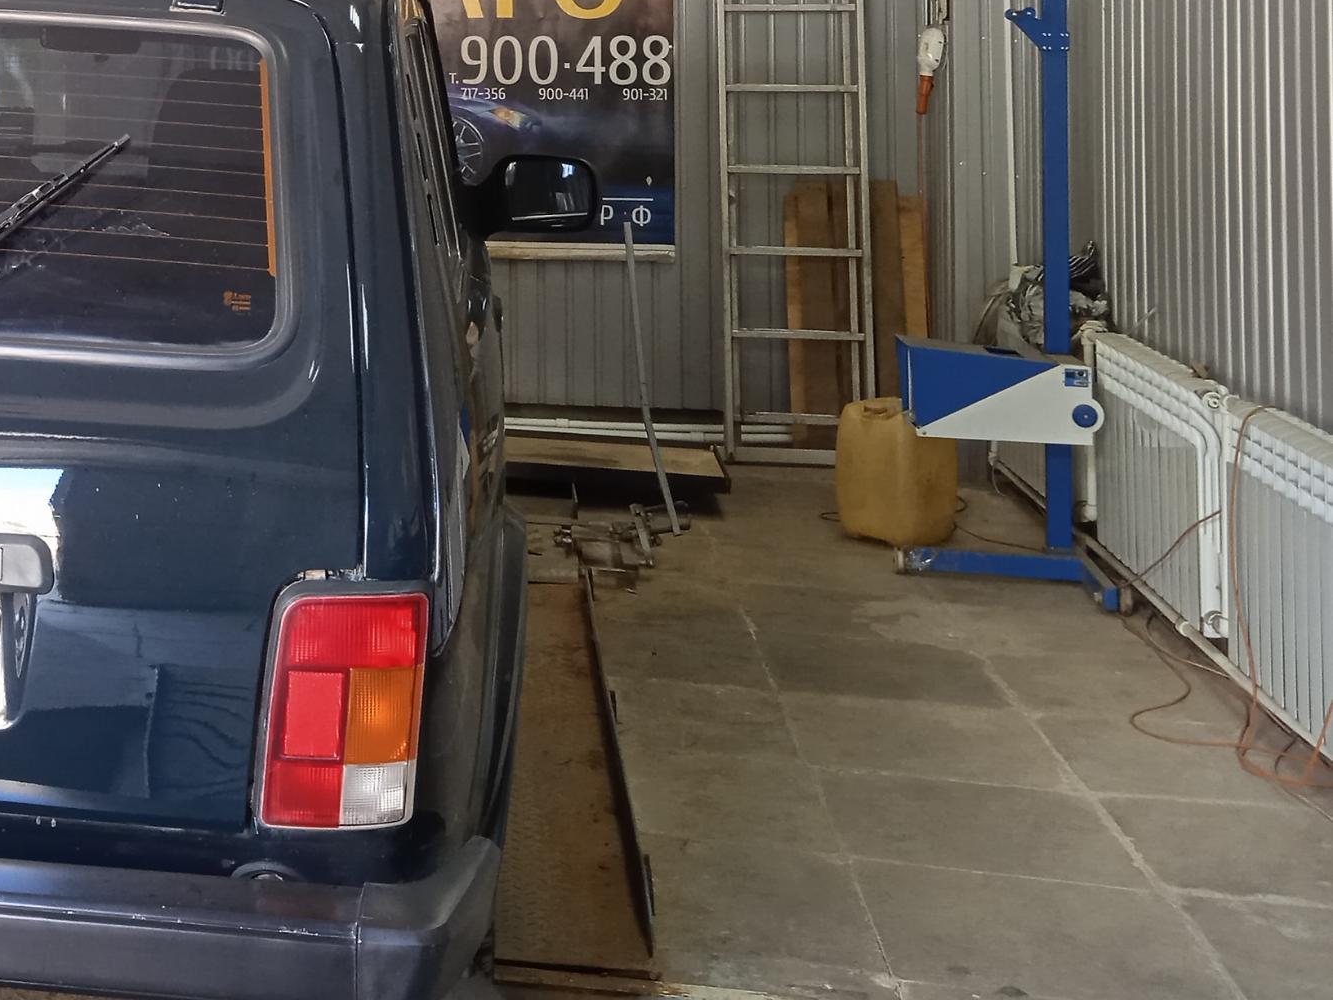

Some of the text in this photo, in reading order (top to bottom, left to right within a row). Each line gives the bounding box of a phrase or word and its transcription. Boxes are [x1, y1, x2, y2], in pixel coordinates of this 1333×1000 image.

[460, 87, 668, 100] 717-356 900-441 901-321
